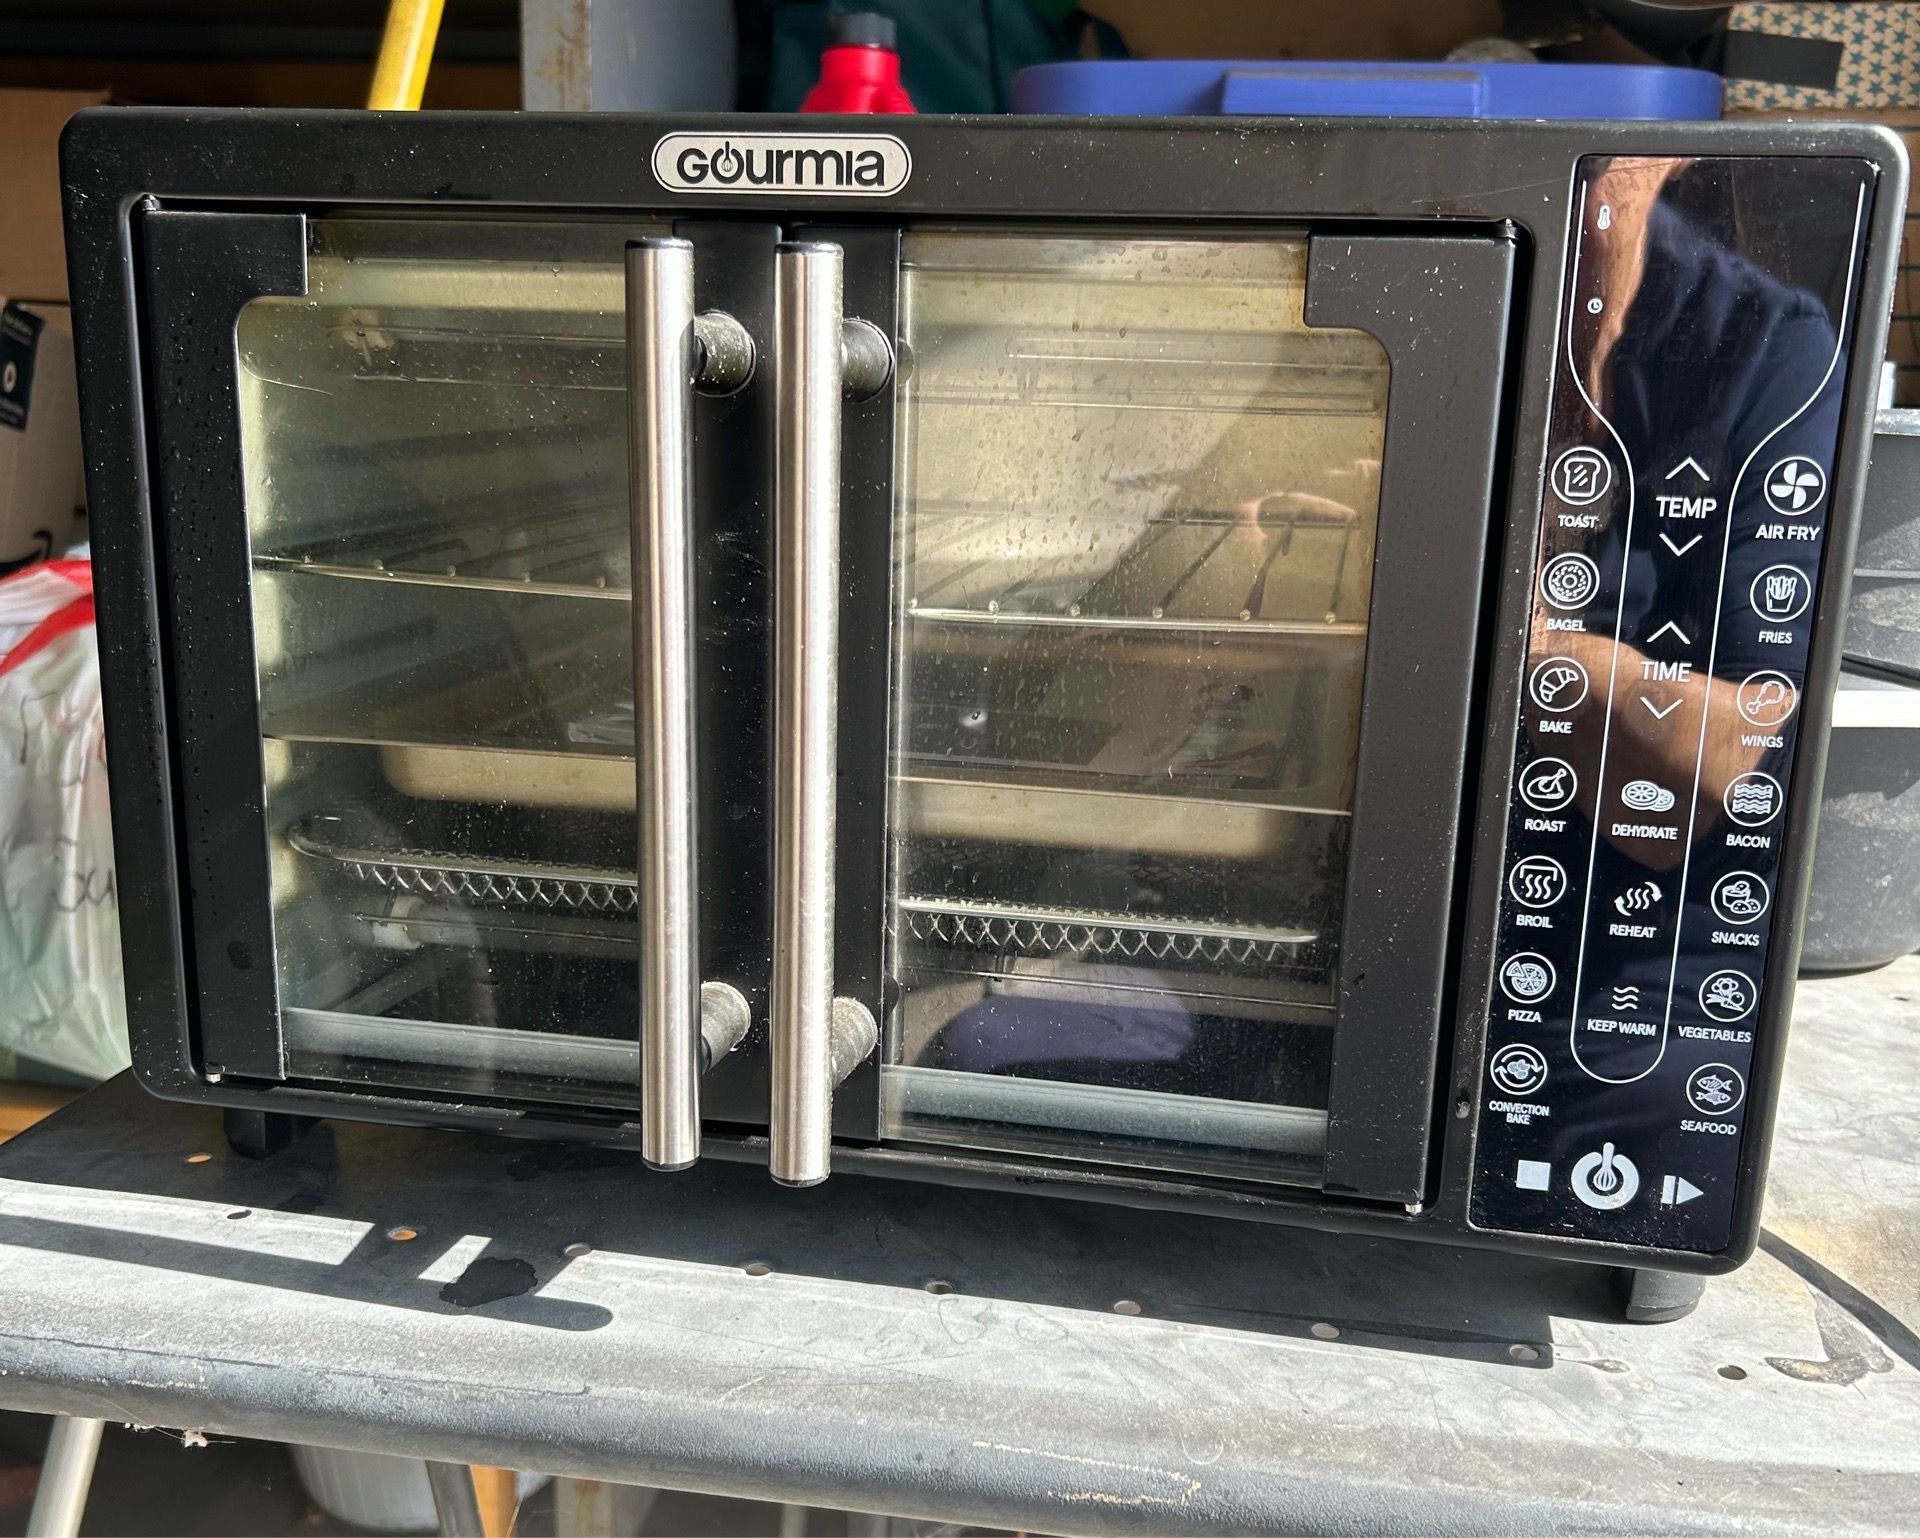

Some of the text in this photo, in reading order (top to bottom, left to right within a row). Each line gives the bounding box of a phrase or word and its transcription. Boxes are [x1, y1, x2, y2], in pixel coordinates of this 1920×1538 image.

[1656, 496, 1717, 519] TEMP
[1557, 514, 1597, 529] TOAST
[1755, 524, 1820, 541] AIR FRY
[1546, 618, 1586, 632] BAGEL
[1758, 630, 1793, 644] FRIES
[1641, 661, 1692, 682] TIME
[1539, 720, 1572, 734] BAKE
[1741, 734, 1784, 748] WINGS
[1524, 818, 1566, 833] ROAST
[1611, 823, 1678, 840] DEHYDRATE
[1726, 834, 1770, 849] BACON
[1516, 914, 1553, 929] BROIL
[1609, 924, 1656, 938] REHEAT
[1711, 931, 1760, 947] SNACKS
[1508, 1009, 1542, 1024] PIZZA
[1587, 1019, 1656, 1037] KEEP WARM
[1678, 1026, 1752, 1043] VEGETABLES
[1489, 1101, 1549, 1116] CONVECTION
[1506, 1113, 1531, 1125] BAKE
[1680, 1120, 1737, 1135] SEAFOOD
